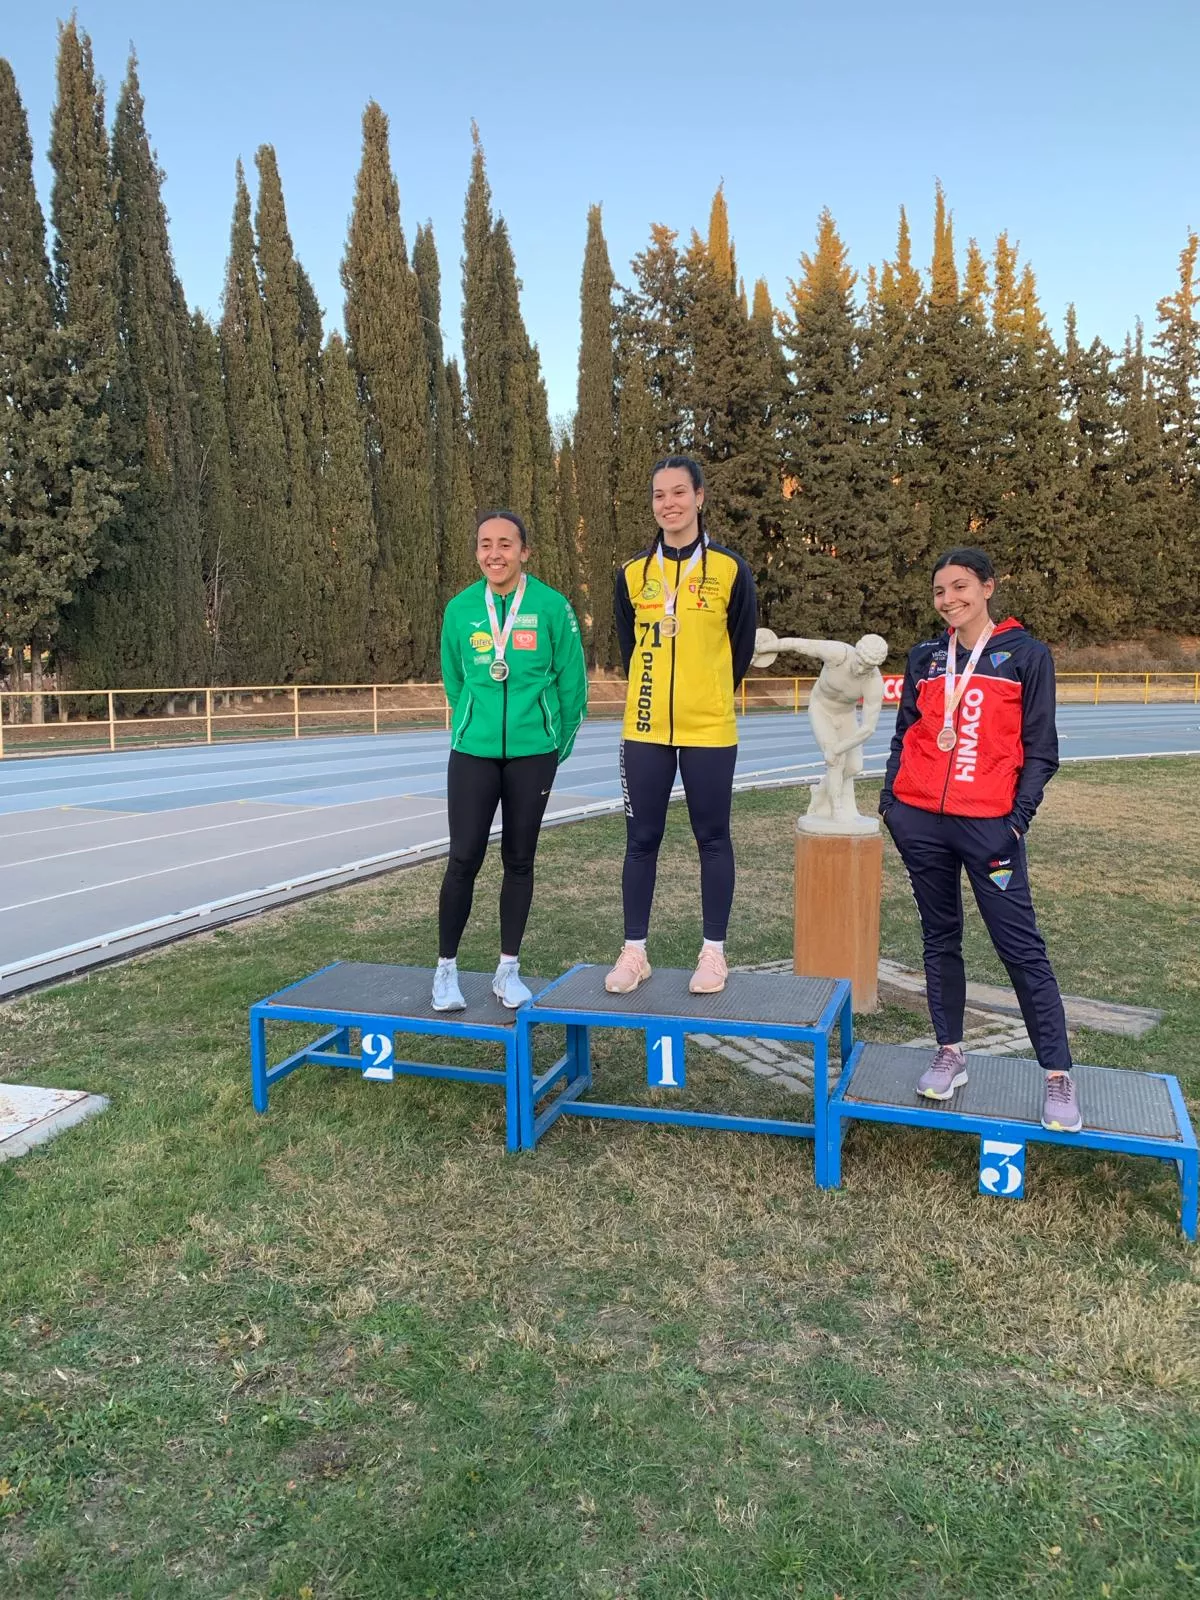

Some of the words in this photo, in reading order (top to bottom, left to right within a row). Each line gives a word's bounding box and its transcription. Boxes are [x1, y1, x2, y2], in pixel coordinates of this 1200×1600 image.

[640, 622, 661, 648] 71
[636, 651, 653, 733] SCORPIO
[954, 688, 984, 782] HINACO
[361, 1033, 393, 1080] 2
[652, 1036, 678, 1085] 1
[980, 1139, 1023, 1194] 3
